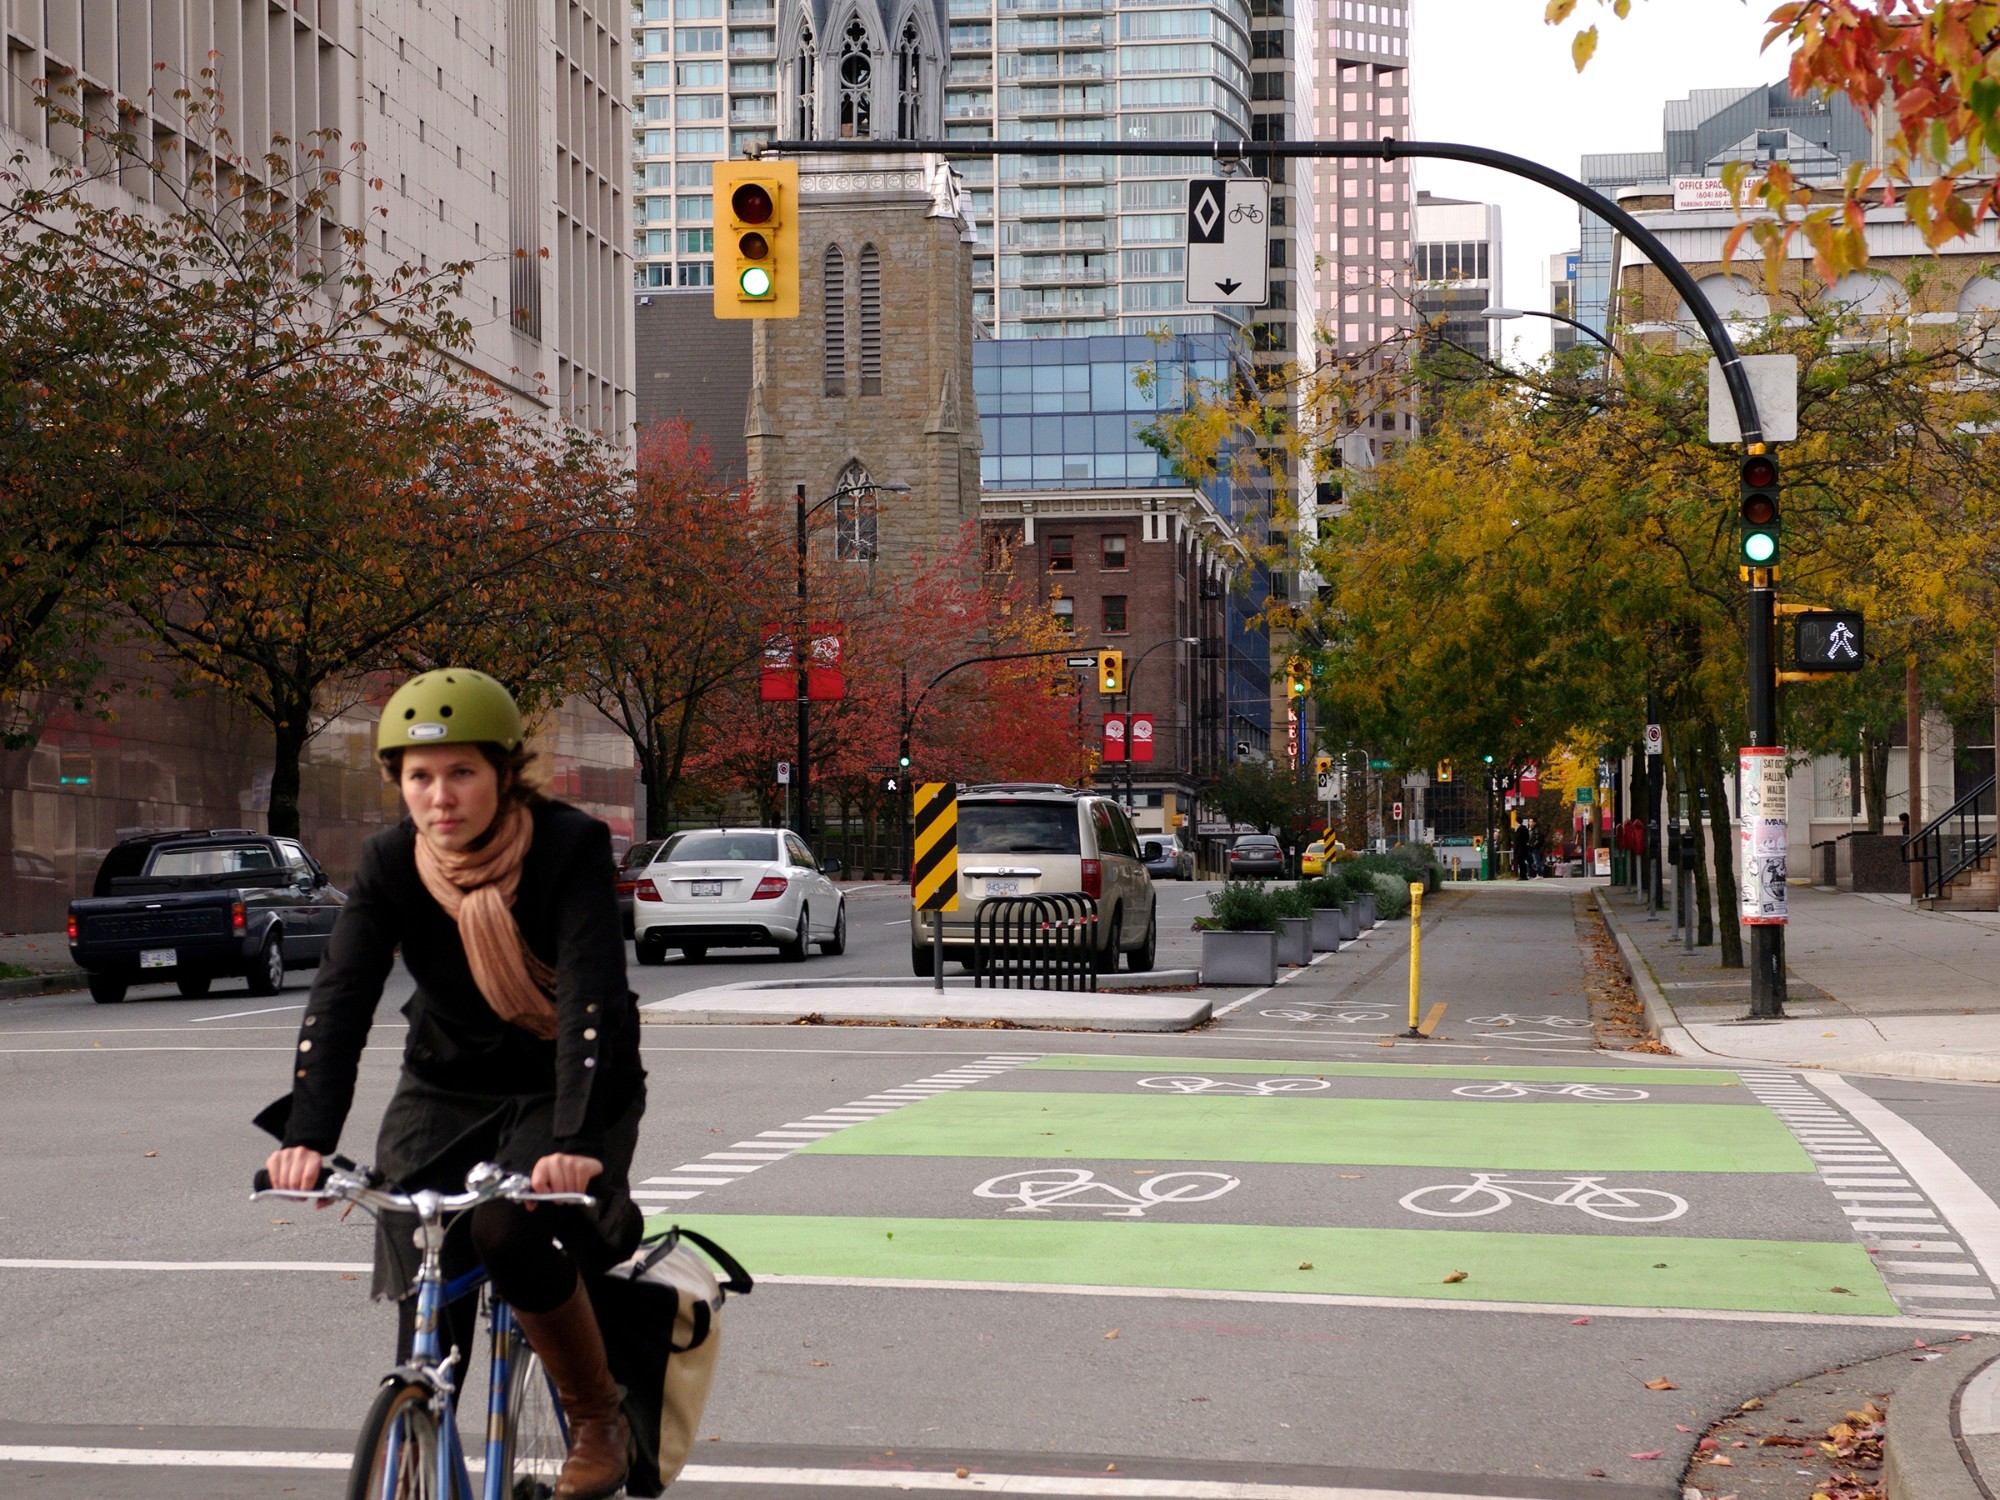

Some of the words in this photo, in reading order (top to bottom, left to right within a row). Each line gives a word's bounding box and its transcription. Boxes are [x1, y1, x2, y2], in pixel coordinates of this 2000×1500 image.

[1679, 181, 1703, 190] OFFICE
[1705, 180, 1724, 189] SPAC
[1696, 191, 1713, 199] (604)
[1763, 759, 1774, 769] SAT
[99, 916, 212, 933] VOLKSWAGEN
